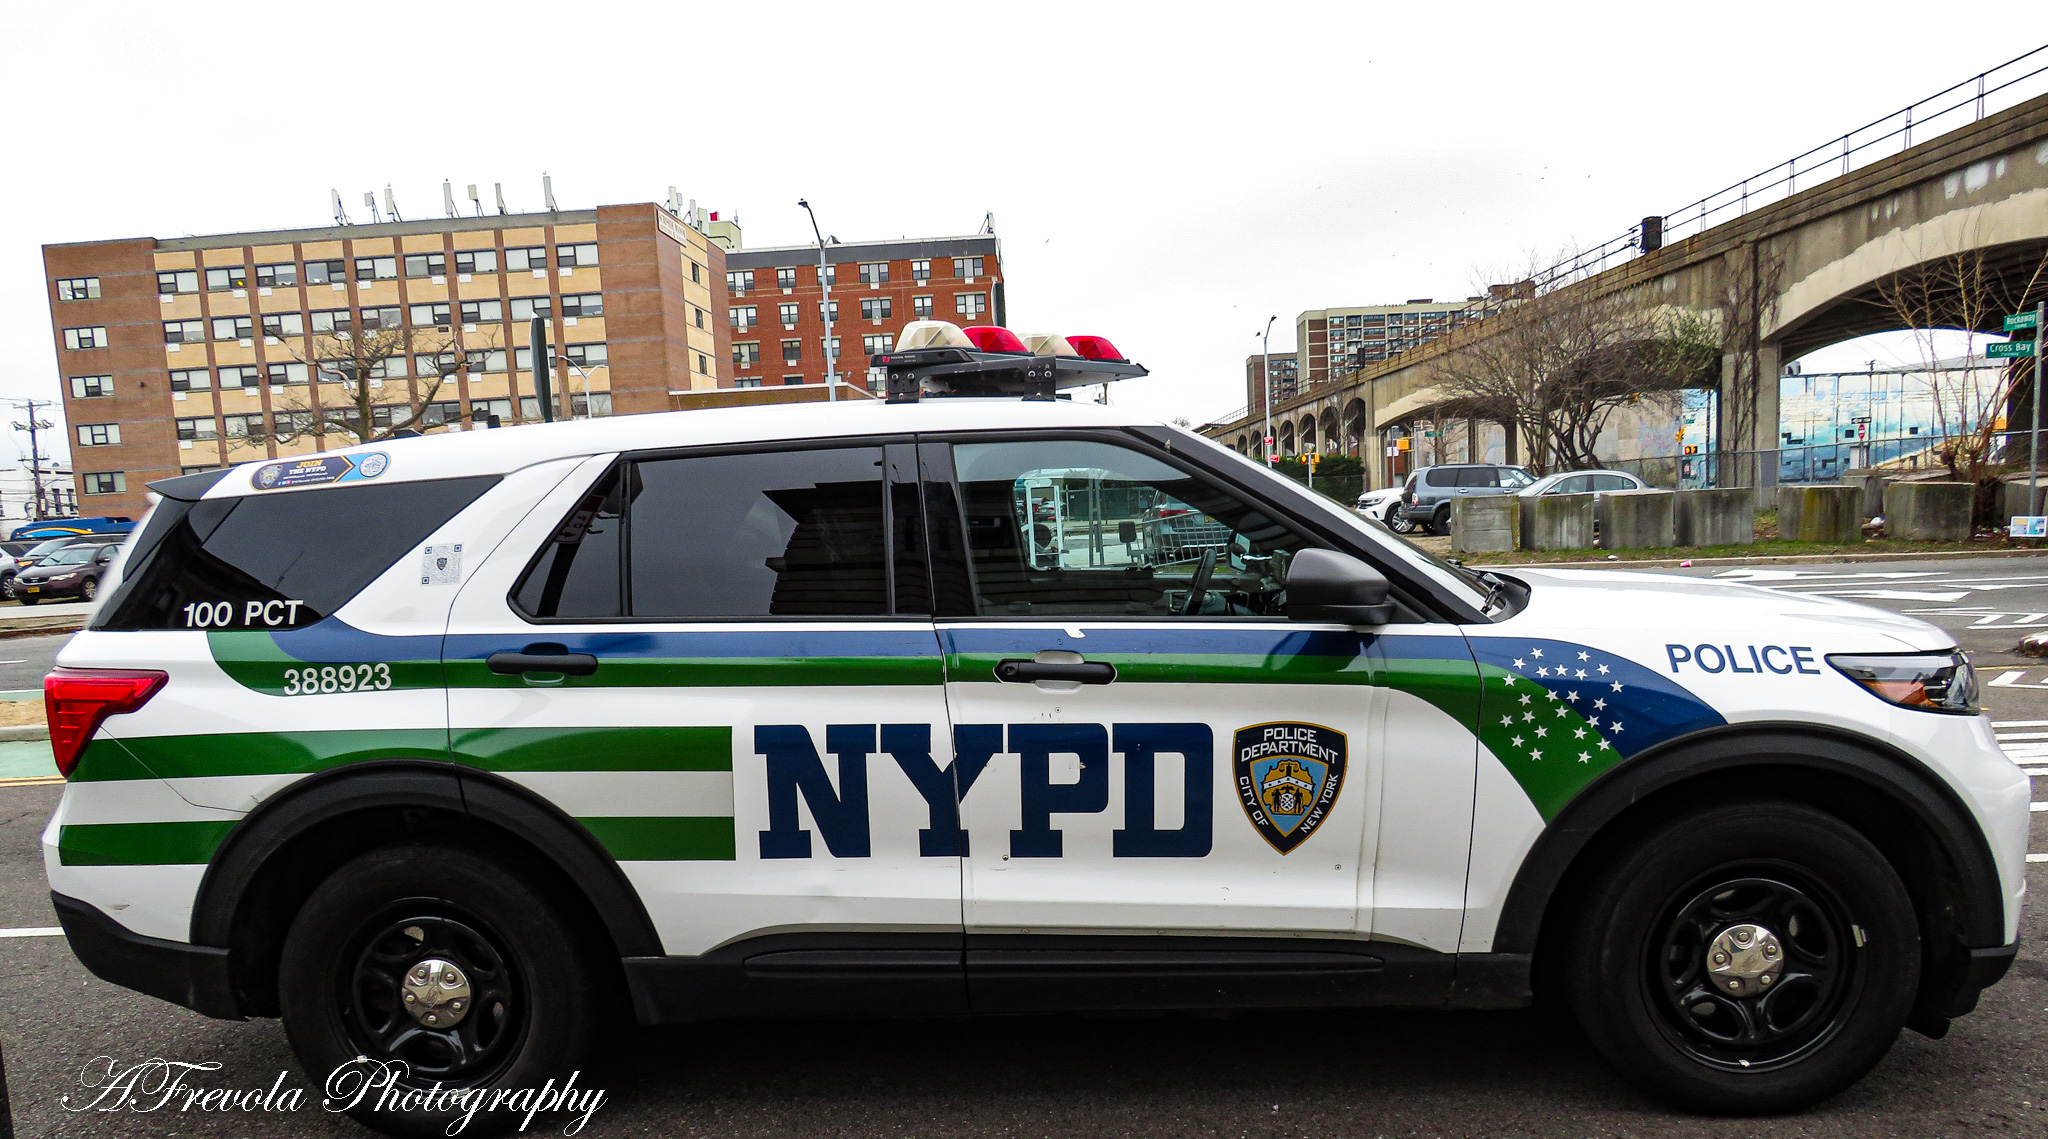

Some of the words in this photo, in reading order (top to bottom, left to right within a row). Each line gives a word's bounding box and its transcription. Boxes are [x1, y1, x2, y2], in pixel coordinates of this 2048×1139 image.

[2006, 313, 2036, 325] Rockaway
[1989, 344, 2013, 353] Cross
[2015, 343, 2031, 353] Bay
[295, 460, 324, 469] JOIN
[304, 465, 327, 473] NYPD
[183, 601, 233, 628] 100
[244, 600, 304, 626] PCT
[1665, 643, 1821, 675] POLICE
[283, 663, 393, 696] 388923
[1263, 727, 1317, 742] POLICE
[1241, 741, 1339, 764] DEPARTMENT
[753, 722, 1214, 860] NYPD
[1240, 776, 1257, 806] CITY
[1252, 810, 1269, 826] OF
[1300, 806, 1323, 834] NEW
[1319, 773, 1339, 805] YORK
